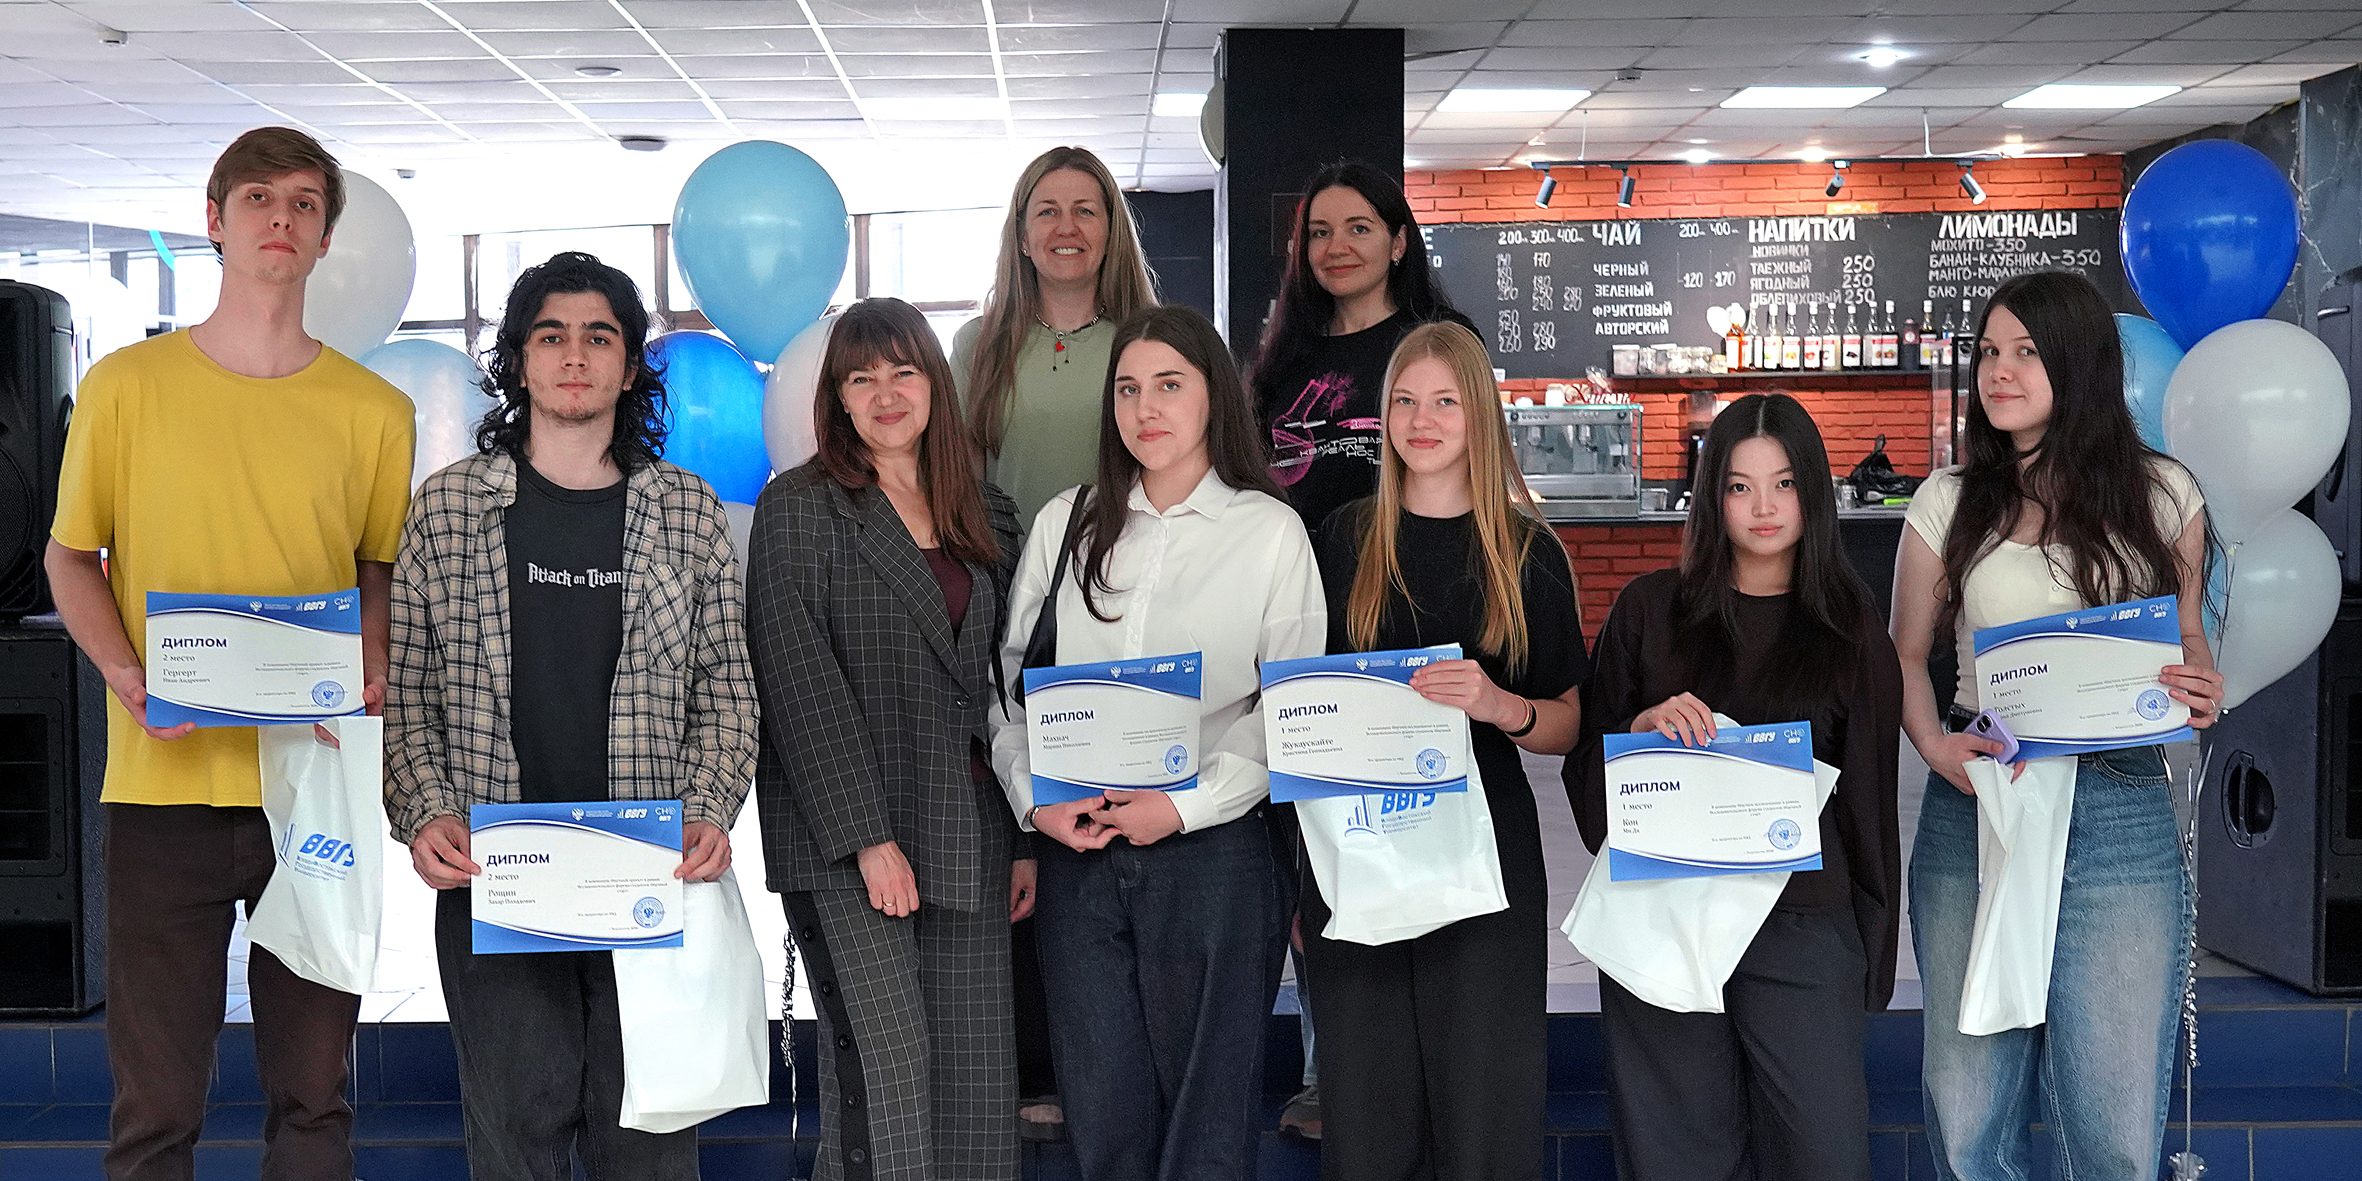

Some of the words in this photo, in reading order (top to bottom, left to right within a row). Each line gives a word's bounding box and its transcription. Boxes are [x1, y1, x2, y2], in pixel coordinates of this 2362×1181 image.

[1592, 220, 1642, 246] ЧАЙ
[1749, 217, 1855, 243] НАПИТКИ
[1938, 212, 2078, 239] ЛИМОНАДЫ
[1533, 252, 1552, 268] 170
[1752, 245, 1809, 258] НОВИНКИ
[1593, 260, 1650, 277] ЧЕРНЫЙ
[1750, 259, 1811, 275] ТАЕЖНЫЙ
[1842, 255, 1876, 274] 250
[1683, 272, 1703, 288] 120
[1715, 271, 1736, 287] 170
[1750, 275, 1810, 291] ЯГОДНЫЙ
[1842, 273, 1873, 288] 250
[1594, 281, 1654, 297] ЗЕЛЕНЫЙ
[1751, 289, 1842, 306] ОБЛЕПИХОВЫЙ
[1845, 288, 1876, 304] 250
[1928, 286, 1957, 299] БЛЮ
[1498, 309, 1519, 326] 250
[1592, 301, 1673, 318] ФРУКТОВЫЙ
[1595, 319, 1669, 336] АВТОРСКИЙ
[1534, 335, 1556, 352] 290
[527, 562, 573, 588] Attack
[573, 575, 586, 585] on
[586, 568, 623, 588] Titan
[161, 637, 228, 649] ДИПЛОМ
[163, 654, 168, 662] 2
[1990, 663, 2048, 685] ДИПЛОМ
[1999, 688, 2022, 697] место
[1040, 709, 1095, 726] ДИПЛОМ
[1278, 703, 1338, 721] ДИПЛОМ
[1287, 726, 1311, 734] место
[1619, 780, 1680, 796] ДИПЛОМ
[486, 853, 551, 867] ДИПЛОМ
[488, 873, 493, 881] 2
